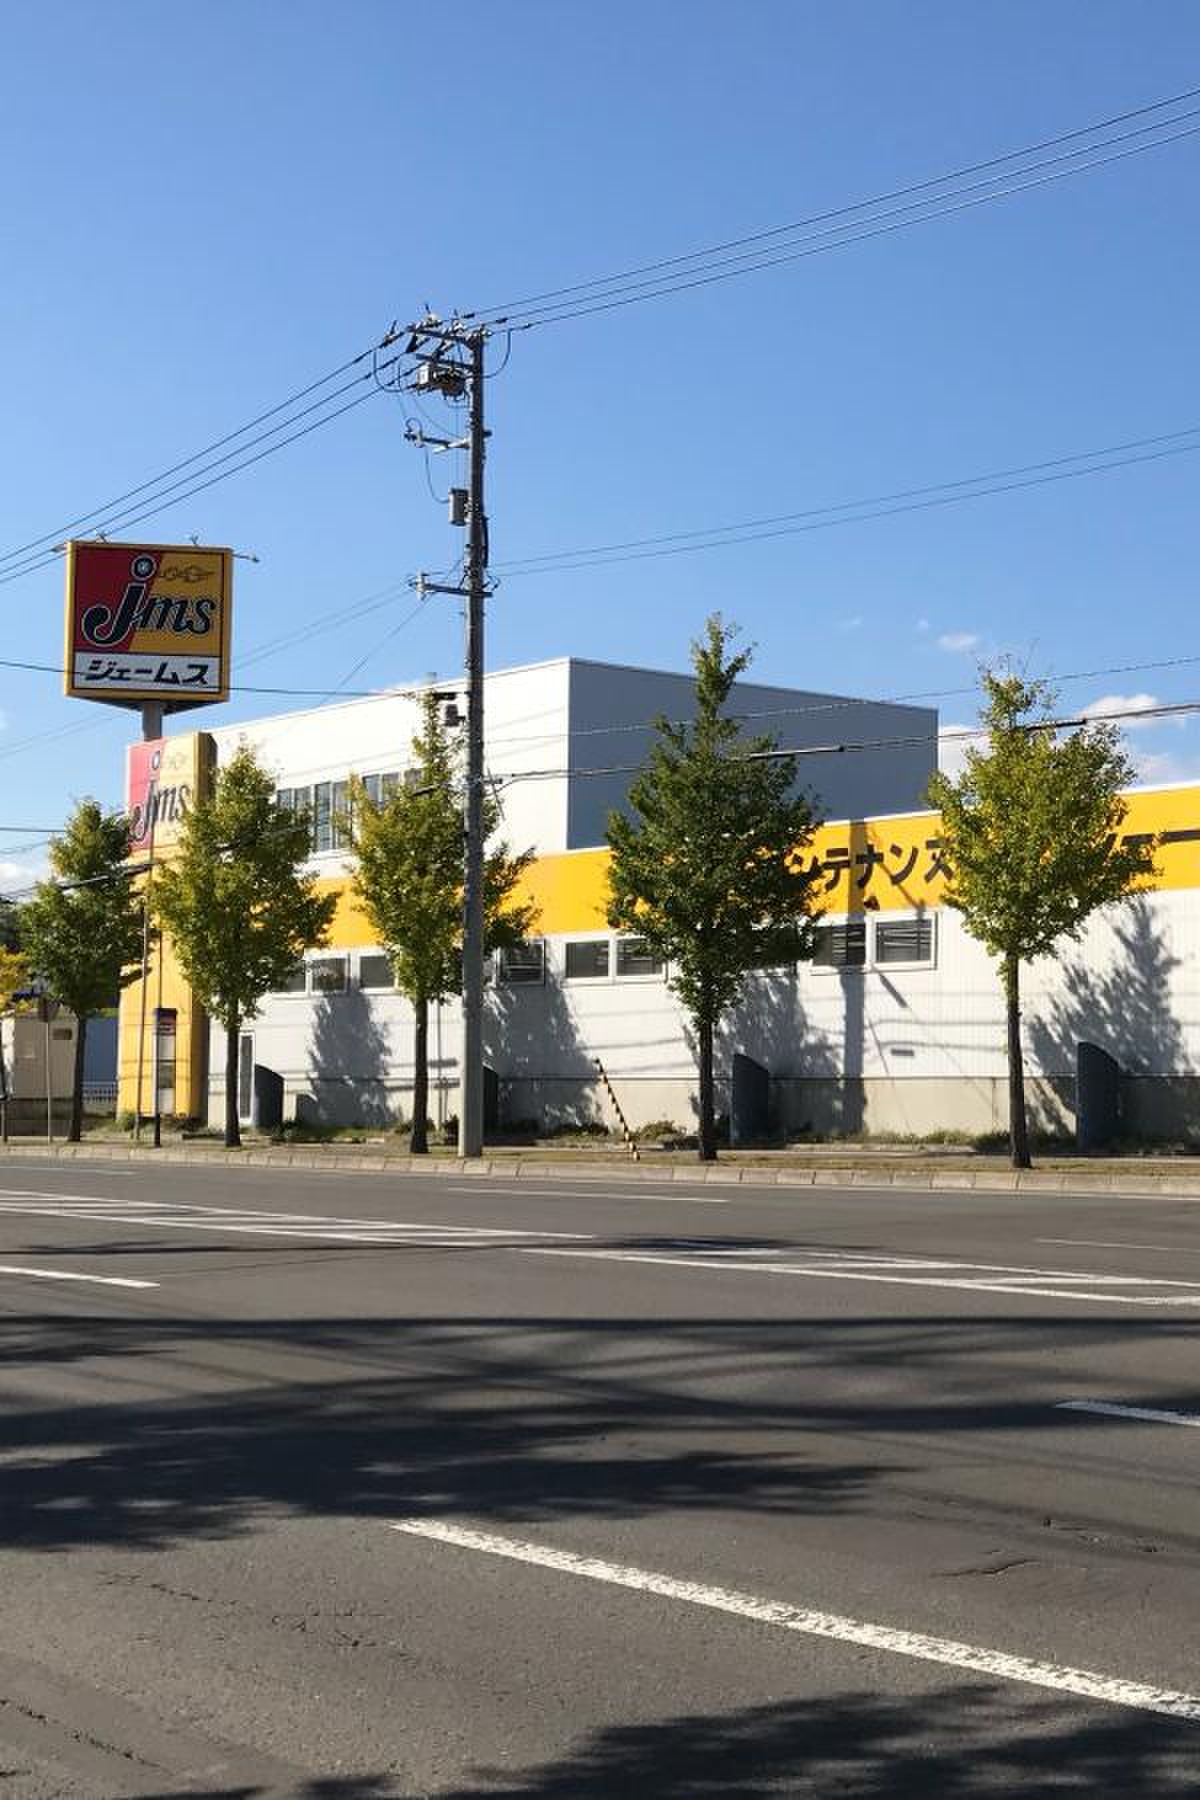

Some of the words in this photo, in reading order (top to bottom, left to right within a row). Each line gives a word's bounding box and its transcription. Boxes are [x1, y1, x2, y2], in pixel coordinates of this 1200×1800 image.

[81, 554, 216, 647] jms
[85, 659, 209, 685] ジェームス
[790, 836, 956, 891] ンテナンス
